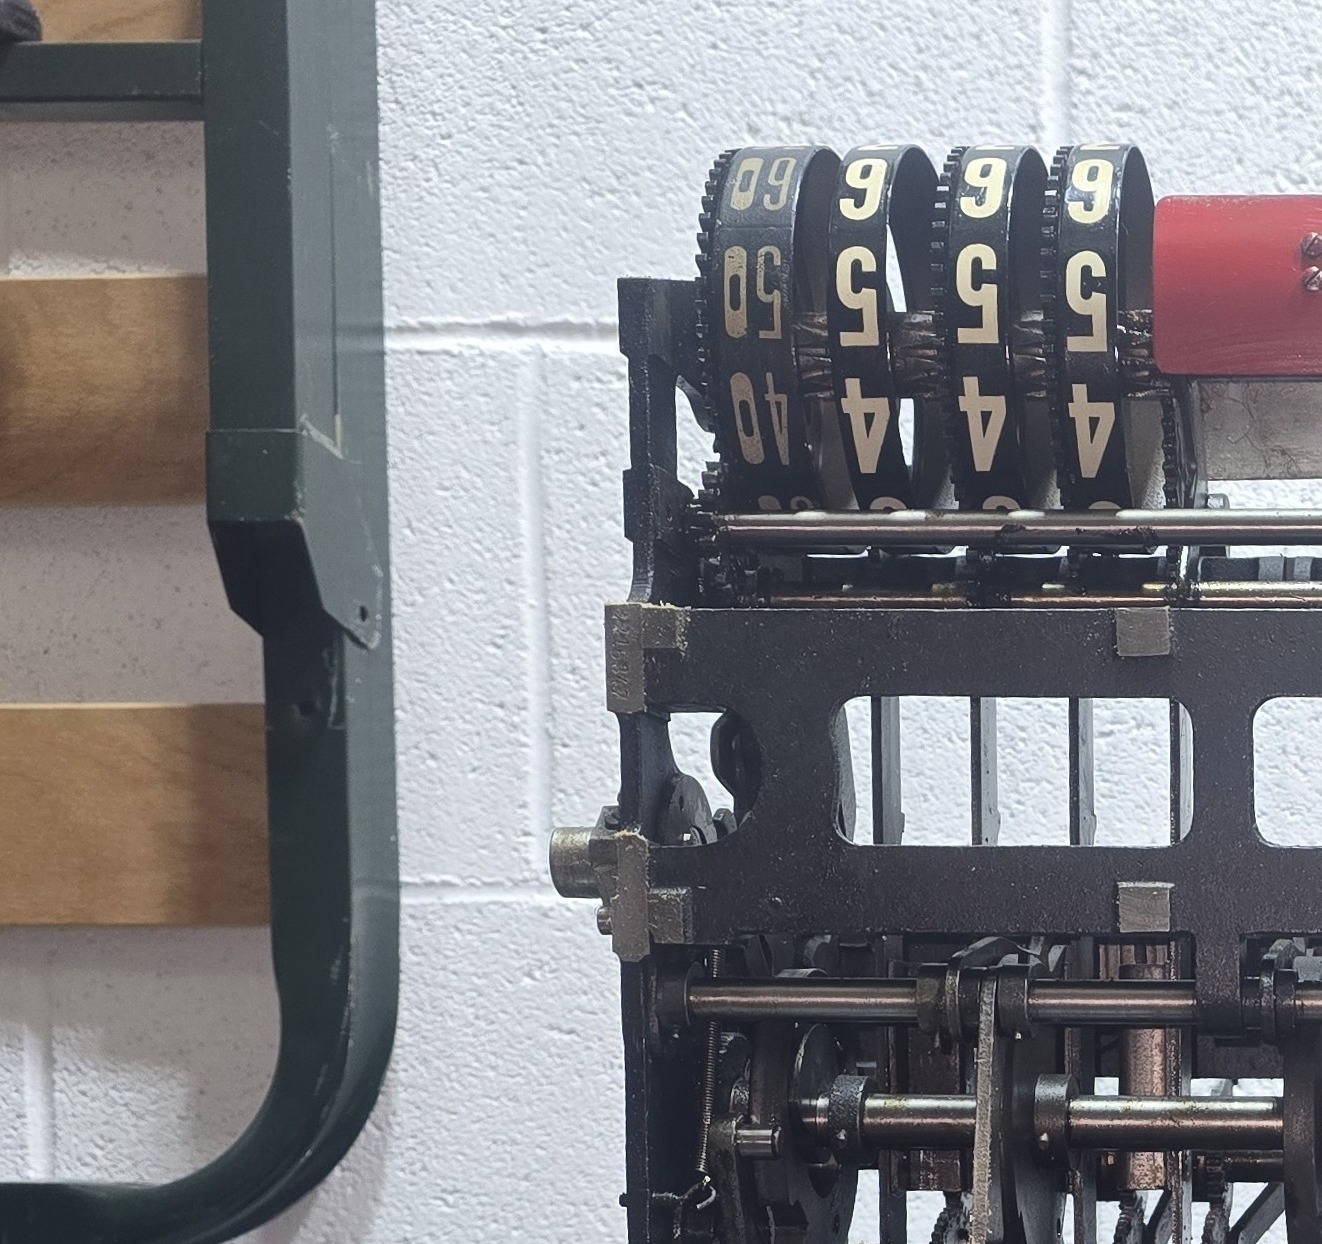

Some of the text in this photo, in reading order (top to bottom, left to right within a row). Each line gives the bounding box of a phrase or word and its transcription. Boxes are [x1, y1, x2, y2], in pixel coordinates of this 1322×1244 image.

[836, 245, 880, 347] 5
[956, 243, 1000, 345] 5
[1065, 250, 1108, 353] 5
[841, 377, 891, 474] 4
[958, 375, 1007, 472] 4
[1068, 383, 1116, 479] 4
